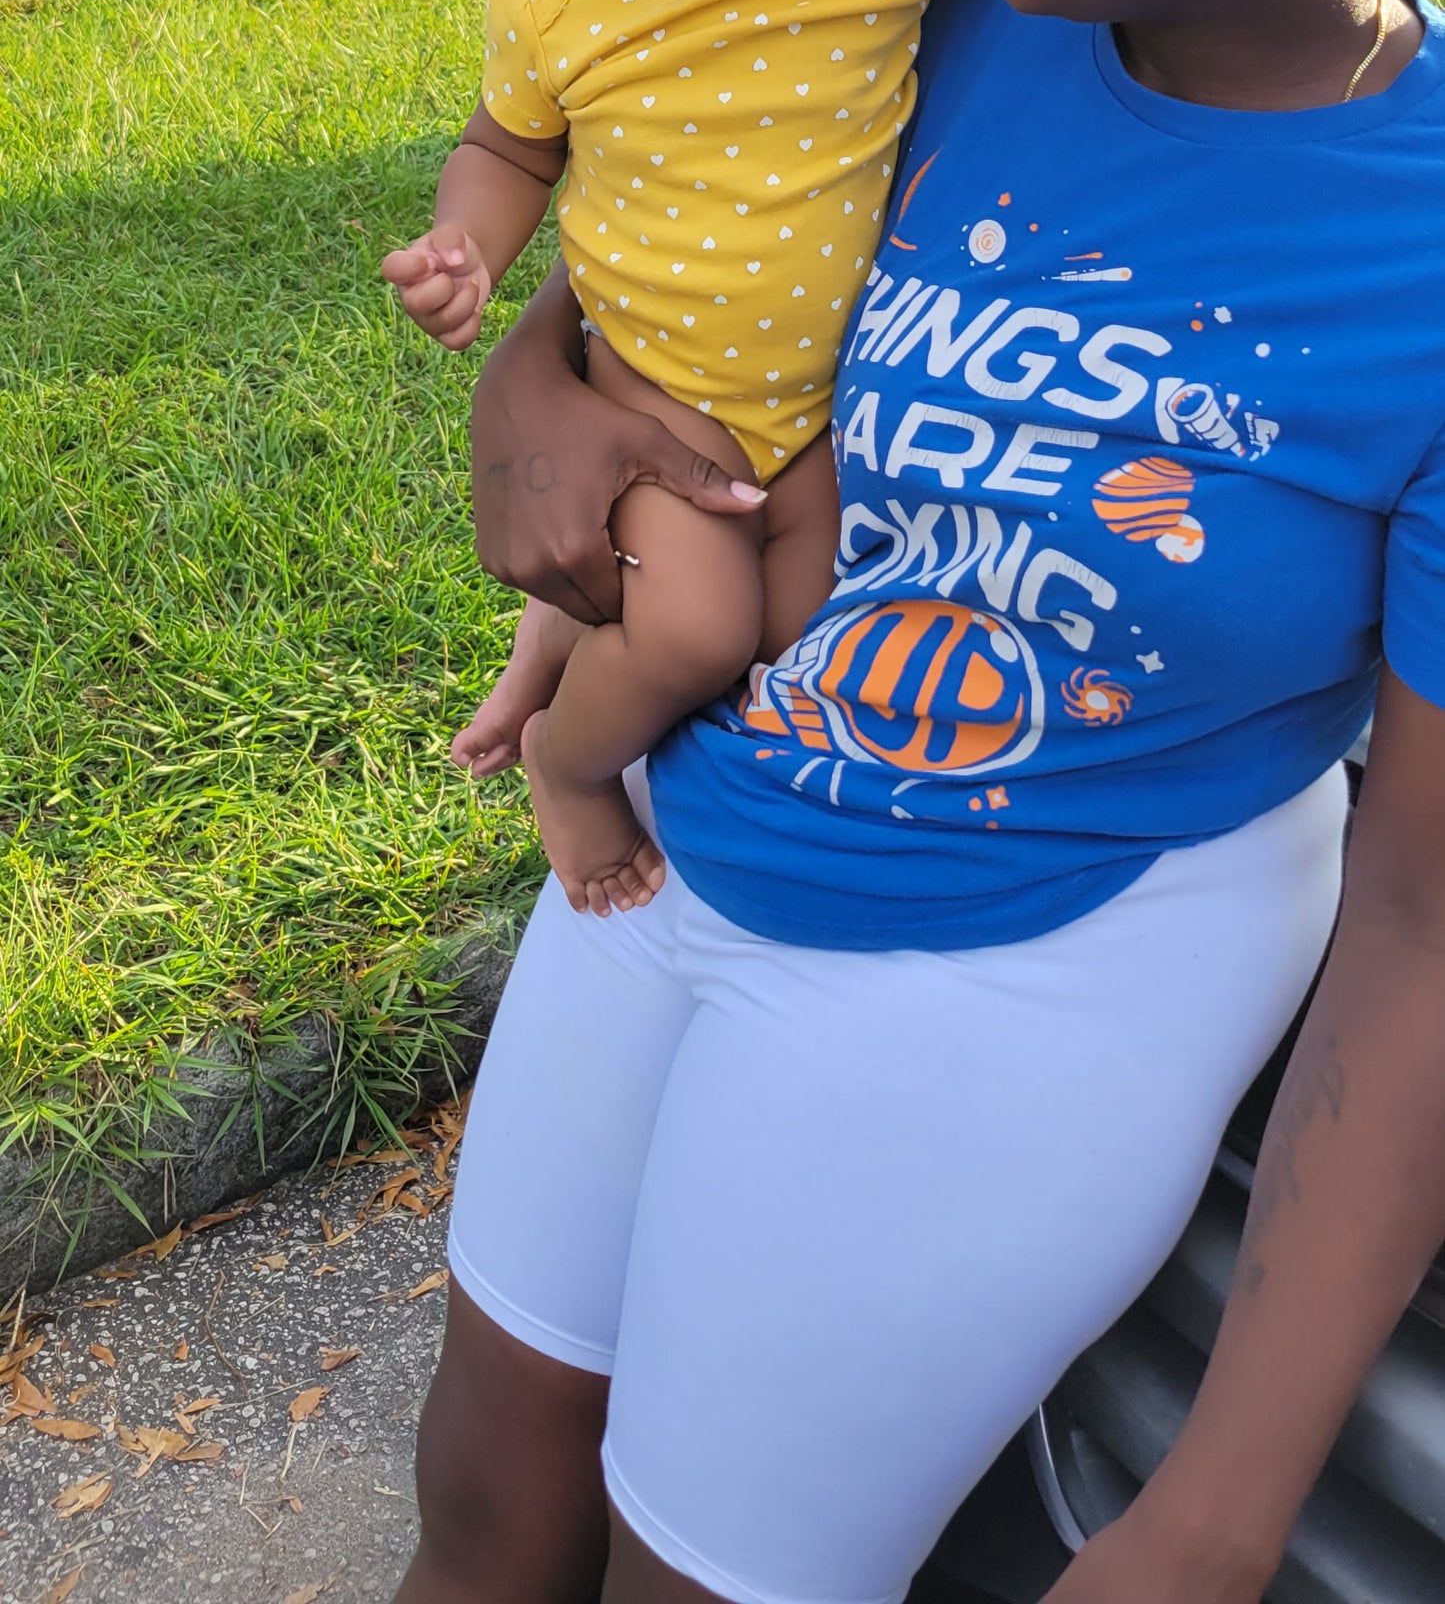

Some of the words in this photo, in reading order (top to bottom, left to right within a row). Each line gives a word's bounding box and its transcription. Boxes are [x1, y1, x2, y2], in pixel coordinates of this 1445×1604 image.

[845, 264, 1173, 420] HINGS
[843, 390, 1100, 497] ARE
[835, 611, 1023, 764] UP
